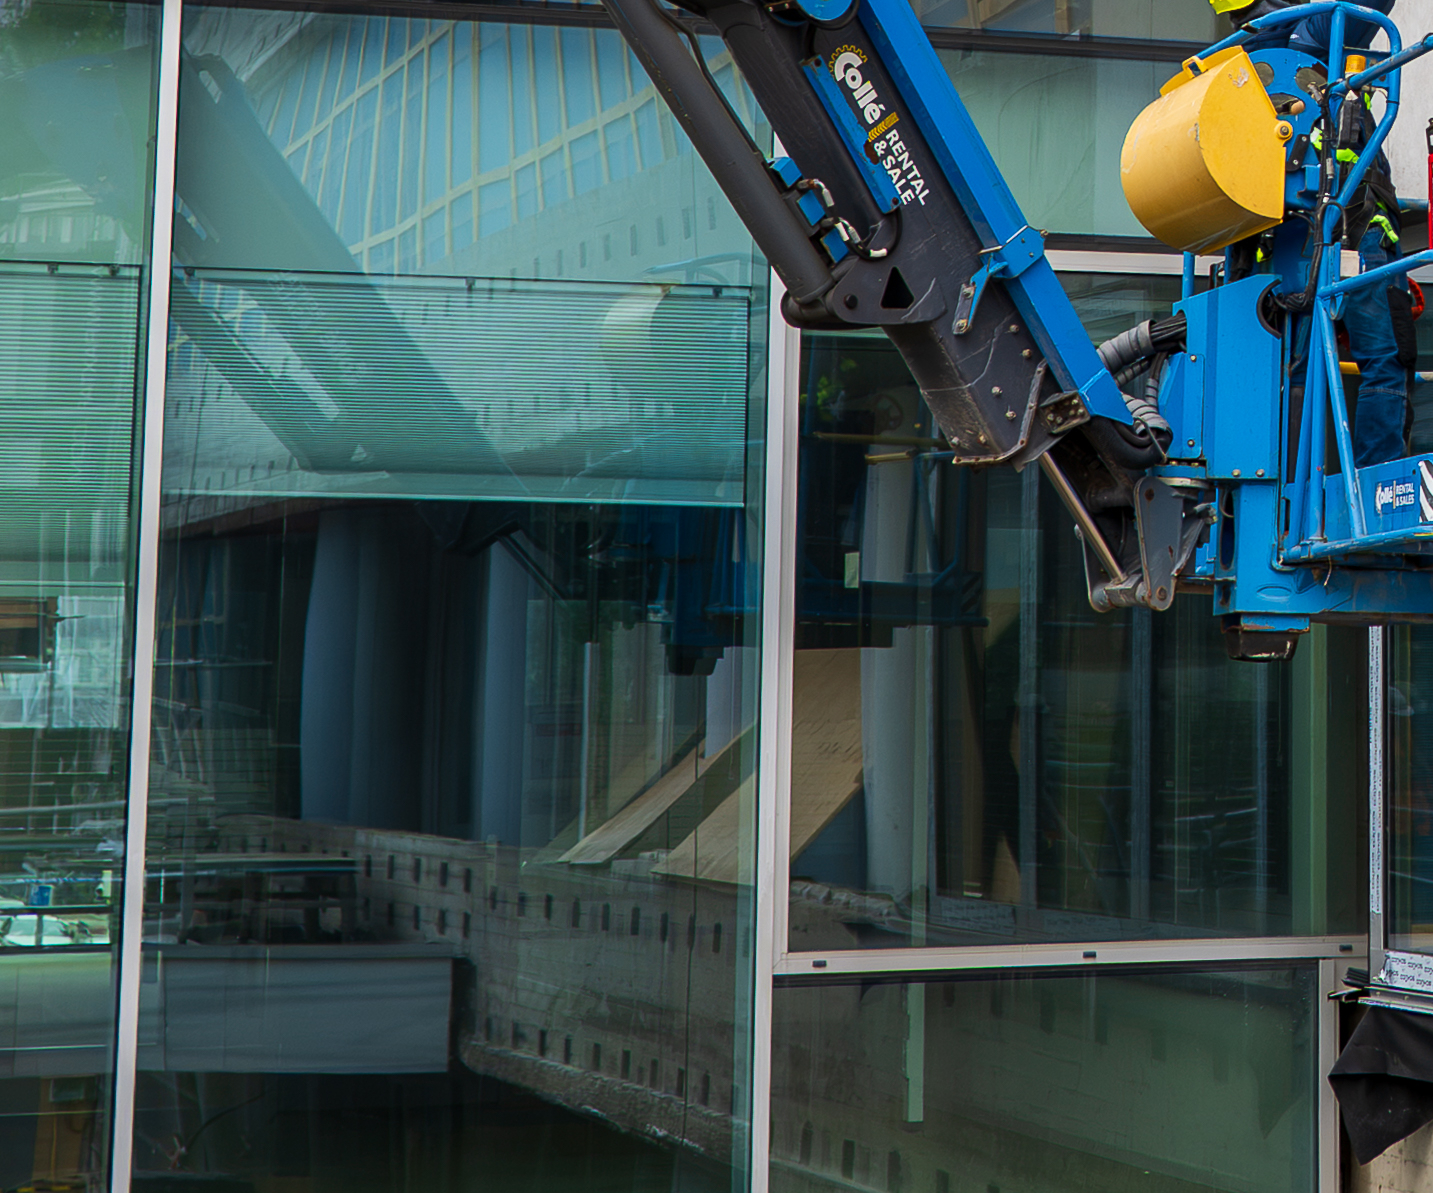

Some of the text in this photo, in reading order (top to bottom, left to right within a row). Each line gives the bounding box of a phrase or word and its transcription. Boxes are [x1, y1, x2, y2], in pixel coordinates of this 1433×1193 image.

[834, 51, 886, 125] Collé
[873, 140, 887, 157] &
[885, 129, 930, 205] RENTAL
[1396, 483, 1415, 495] RENTAL
